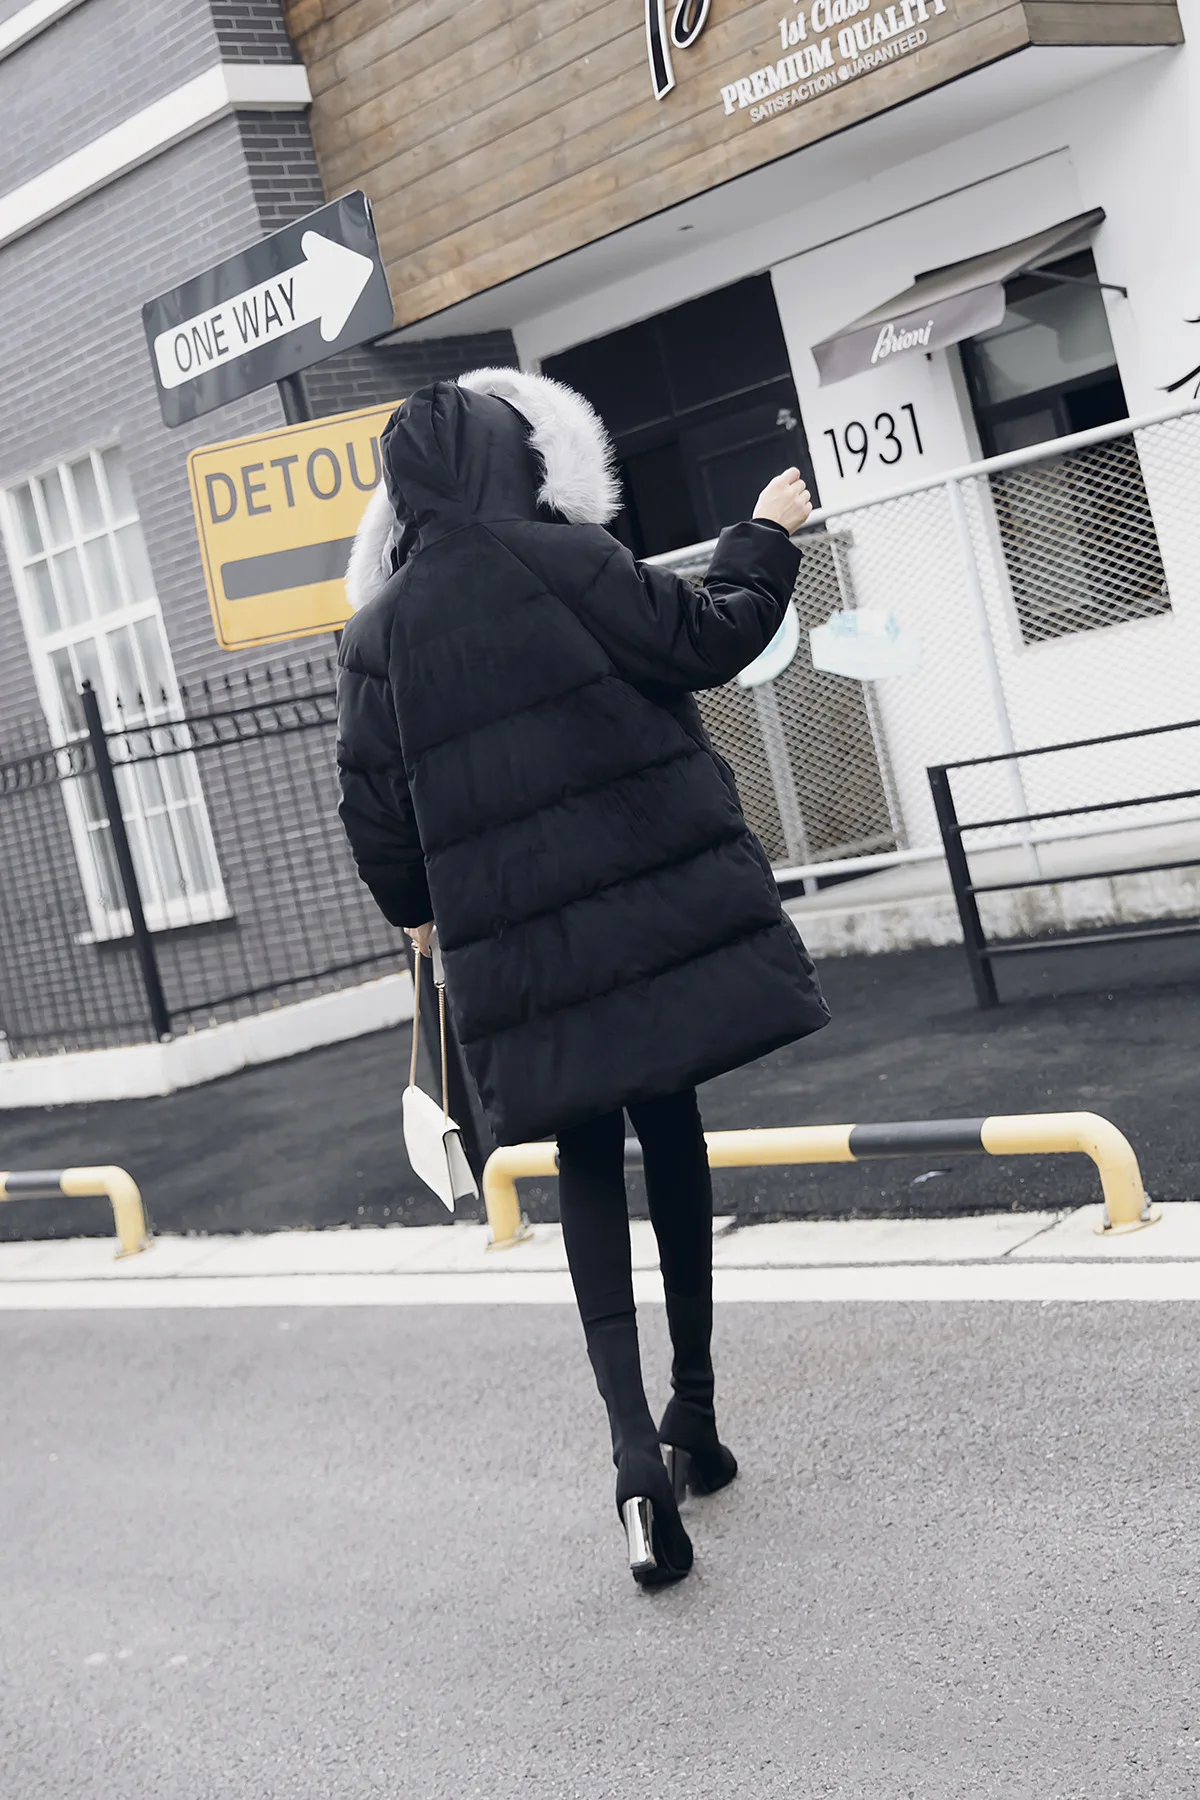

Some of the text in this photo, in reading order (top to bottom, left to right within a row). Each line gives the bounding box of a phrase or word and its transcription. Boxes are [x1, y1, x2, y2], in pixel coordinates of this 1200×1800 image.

[778, 11, 808, 50] 1st
[720, 36, 836, 116] PREMIUM
[749, 70, 838, 123] SATISFACTION
[174, 277, 295, 372] ONE WAY
[871, 319, 934, 364] Brioni
[823, 403, 923, 478] 1931
[205, 436, 382, 524] DETOU
